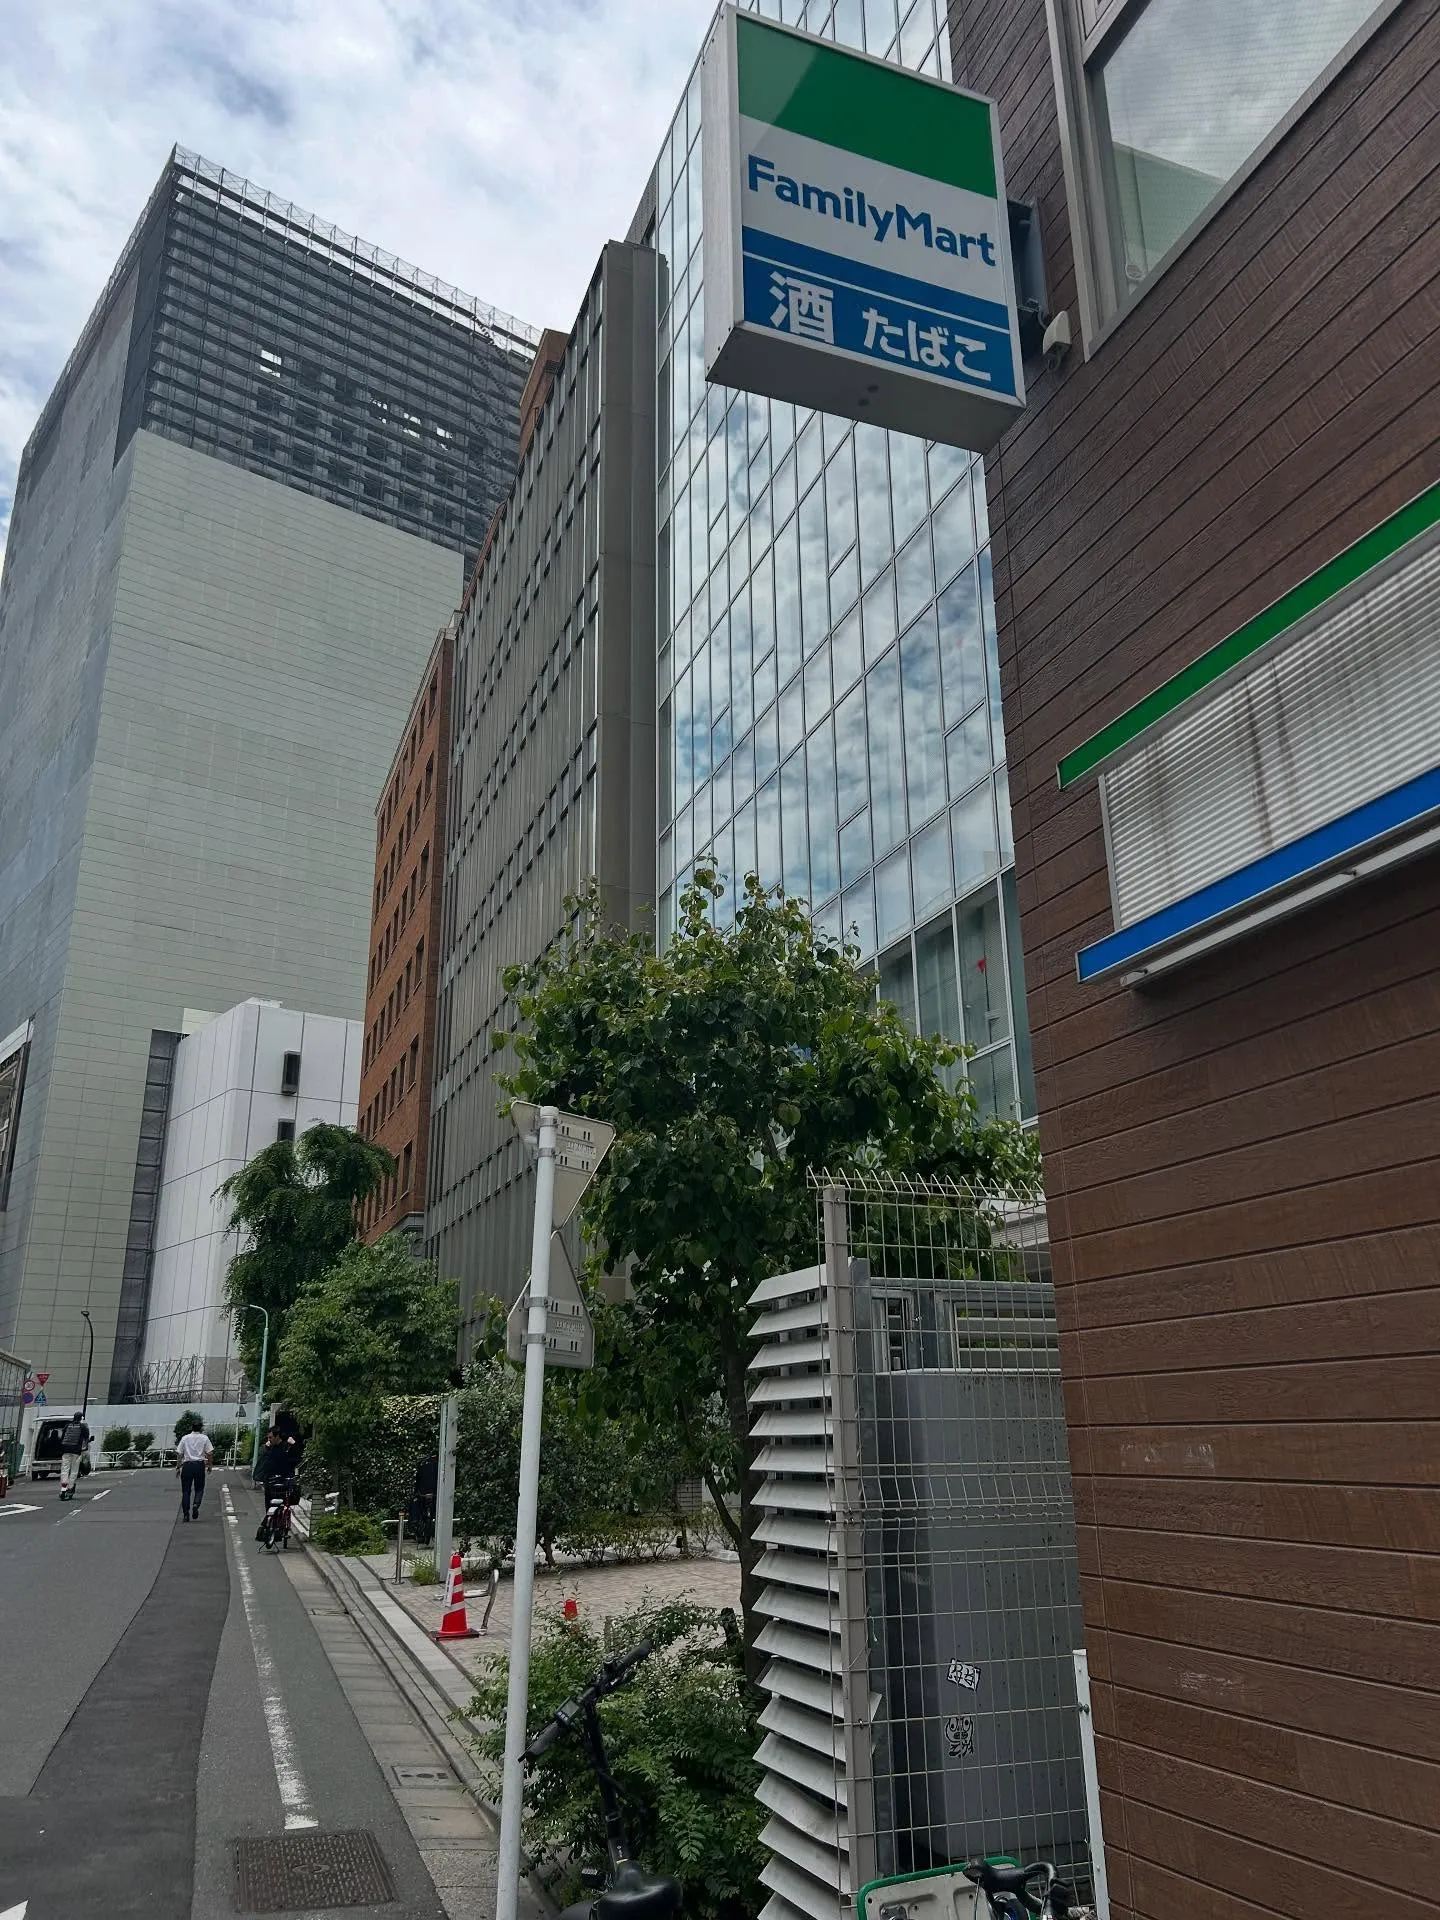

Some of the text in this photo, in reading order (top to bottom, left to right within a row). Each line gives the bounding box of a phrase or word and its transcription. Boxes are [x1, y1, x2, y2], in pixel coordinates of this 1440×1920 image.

[748, 154, 995, 266] FamilyMart
[769, 271, 991, 381] 酒 たばこ
